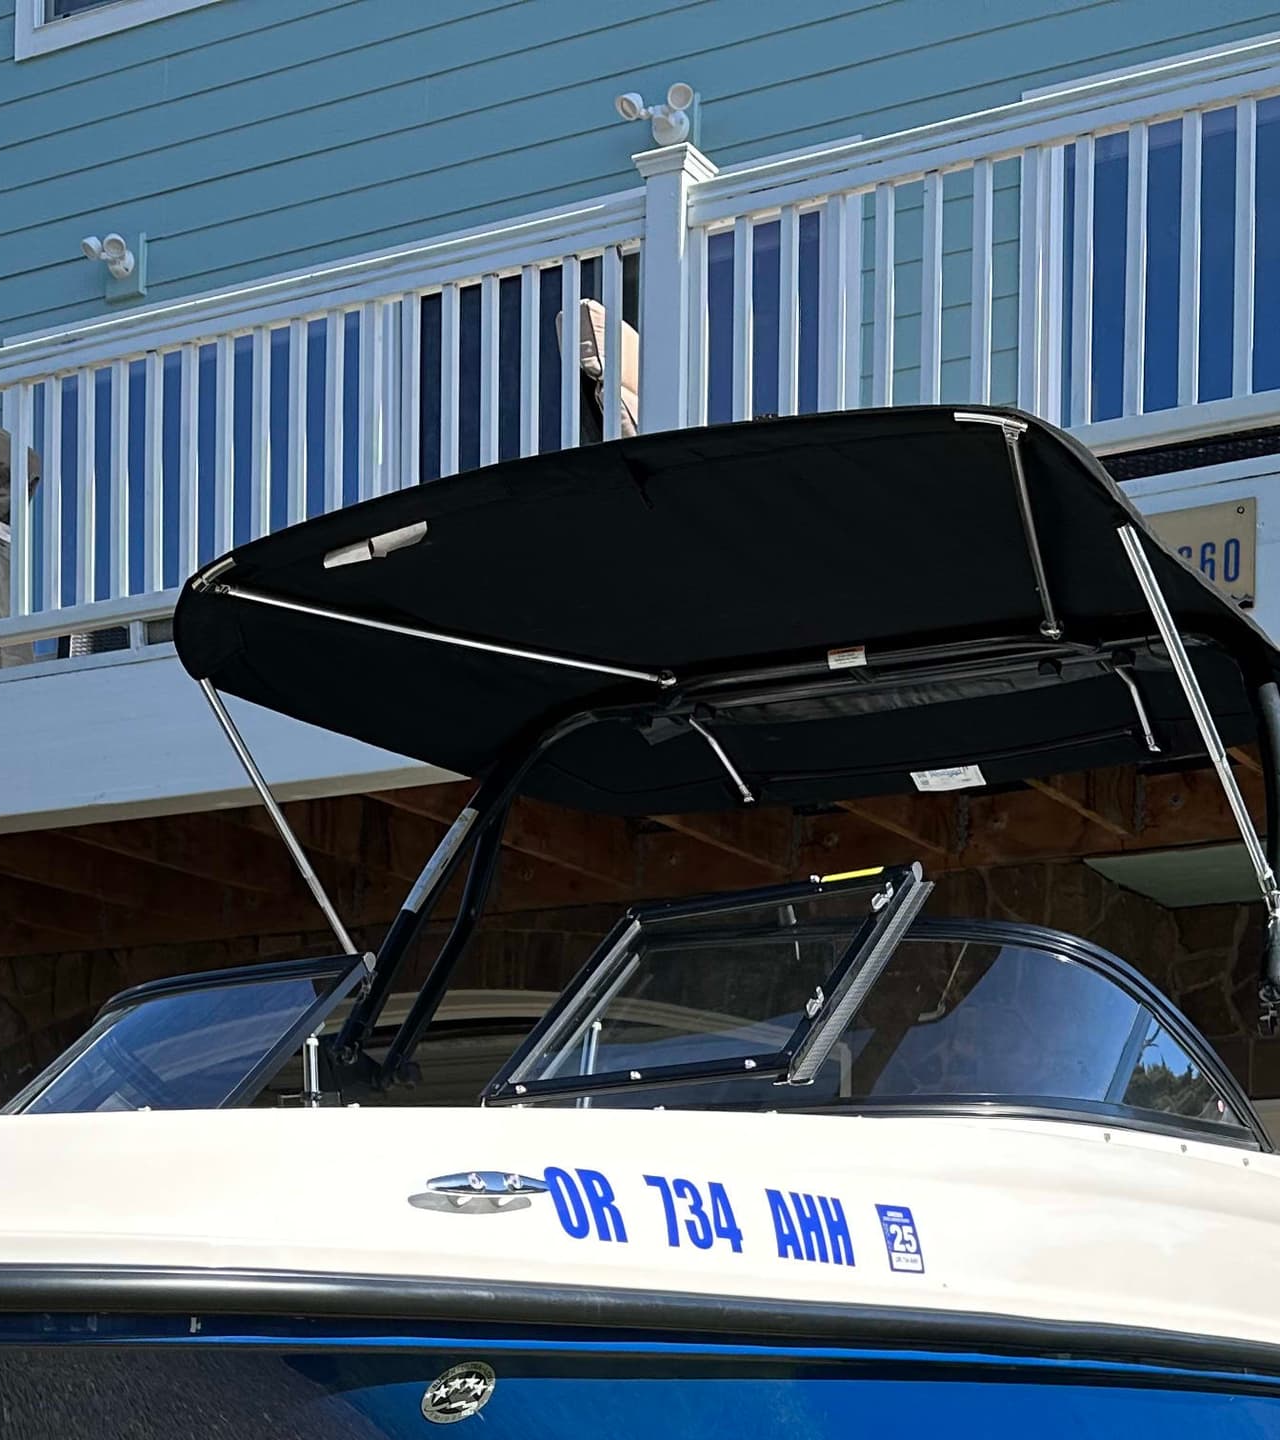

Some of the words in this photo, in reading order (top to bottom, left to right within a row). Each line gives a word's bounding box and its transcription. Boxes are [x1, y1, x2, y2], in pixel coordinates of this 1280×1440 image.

[543, 1166, 629, 1244] OR
[642, 1174, 744, 1254] 734
[764, 1188, 856, 1267] AHH
[889, 1224, 917, 1253] 25
